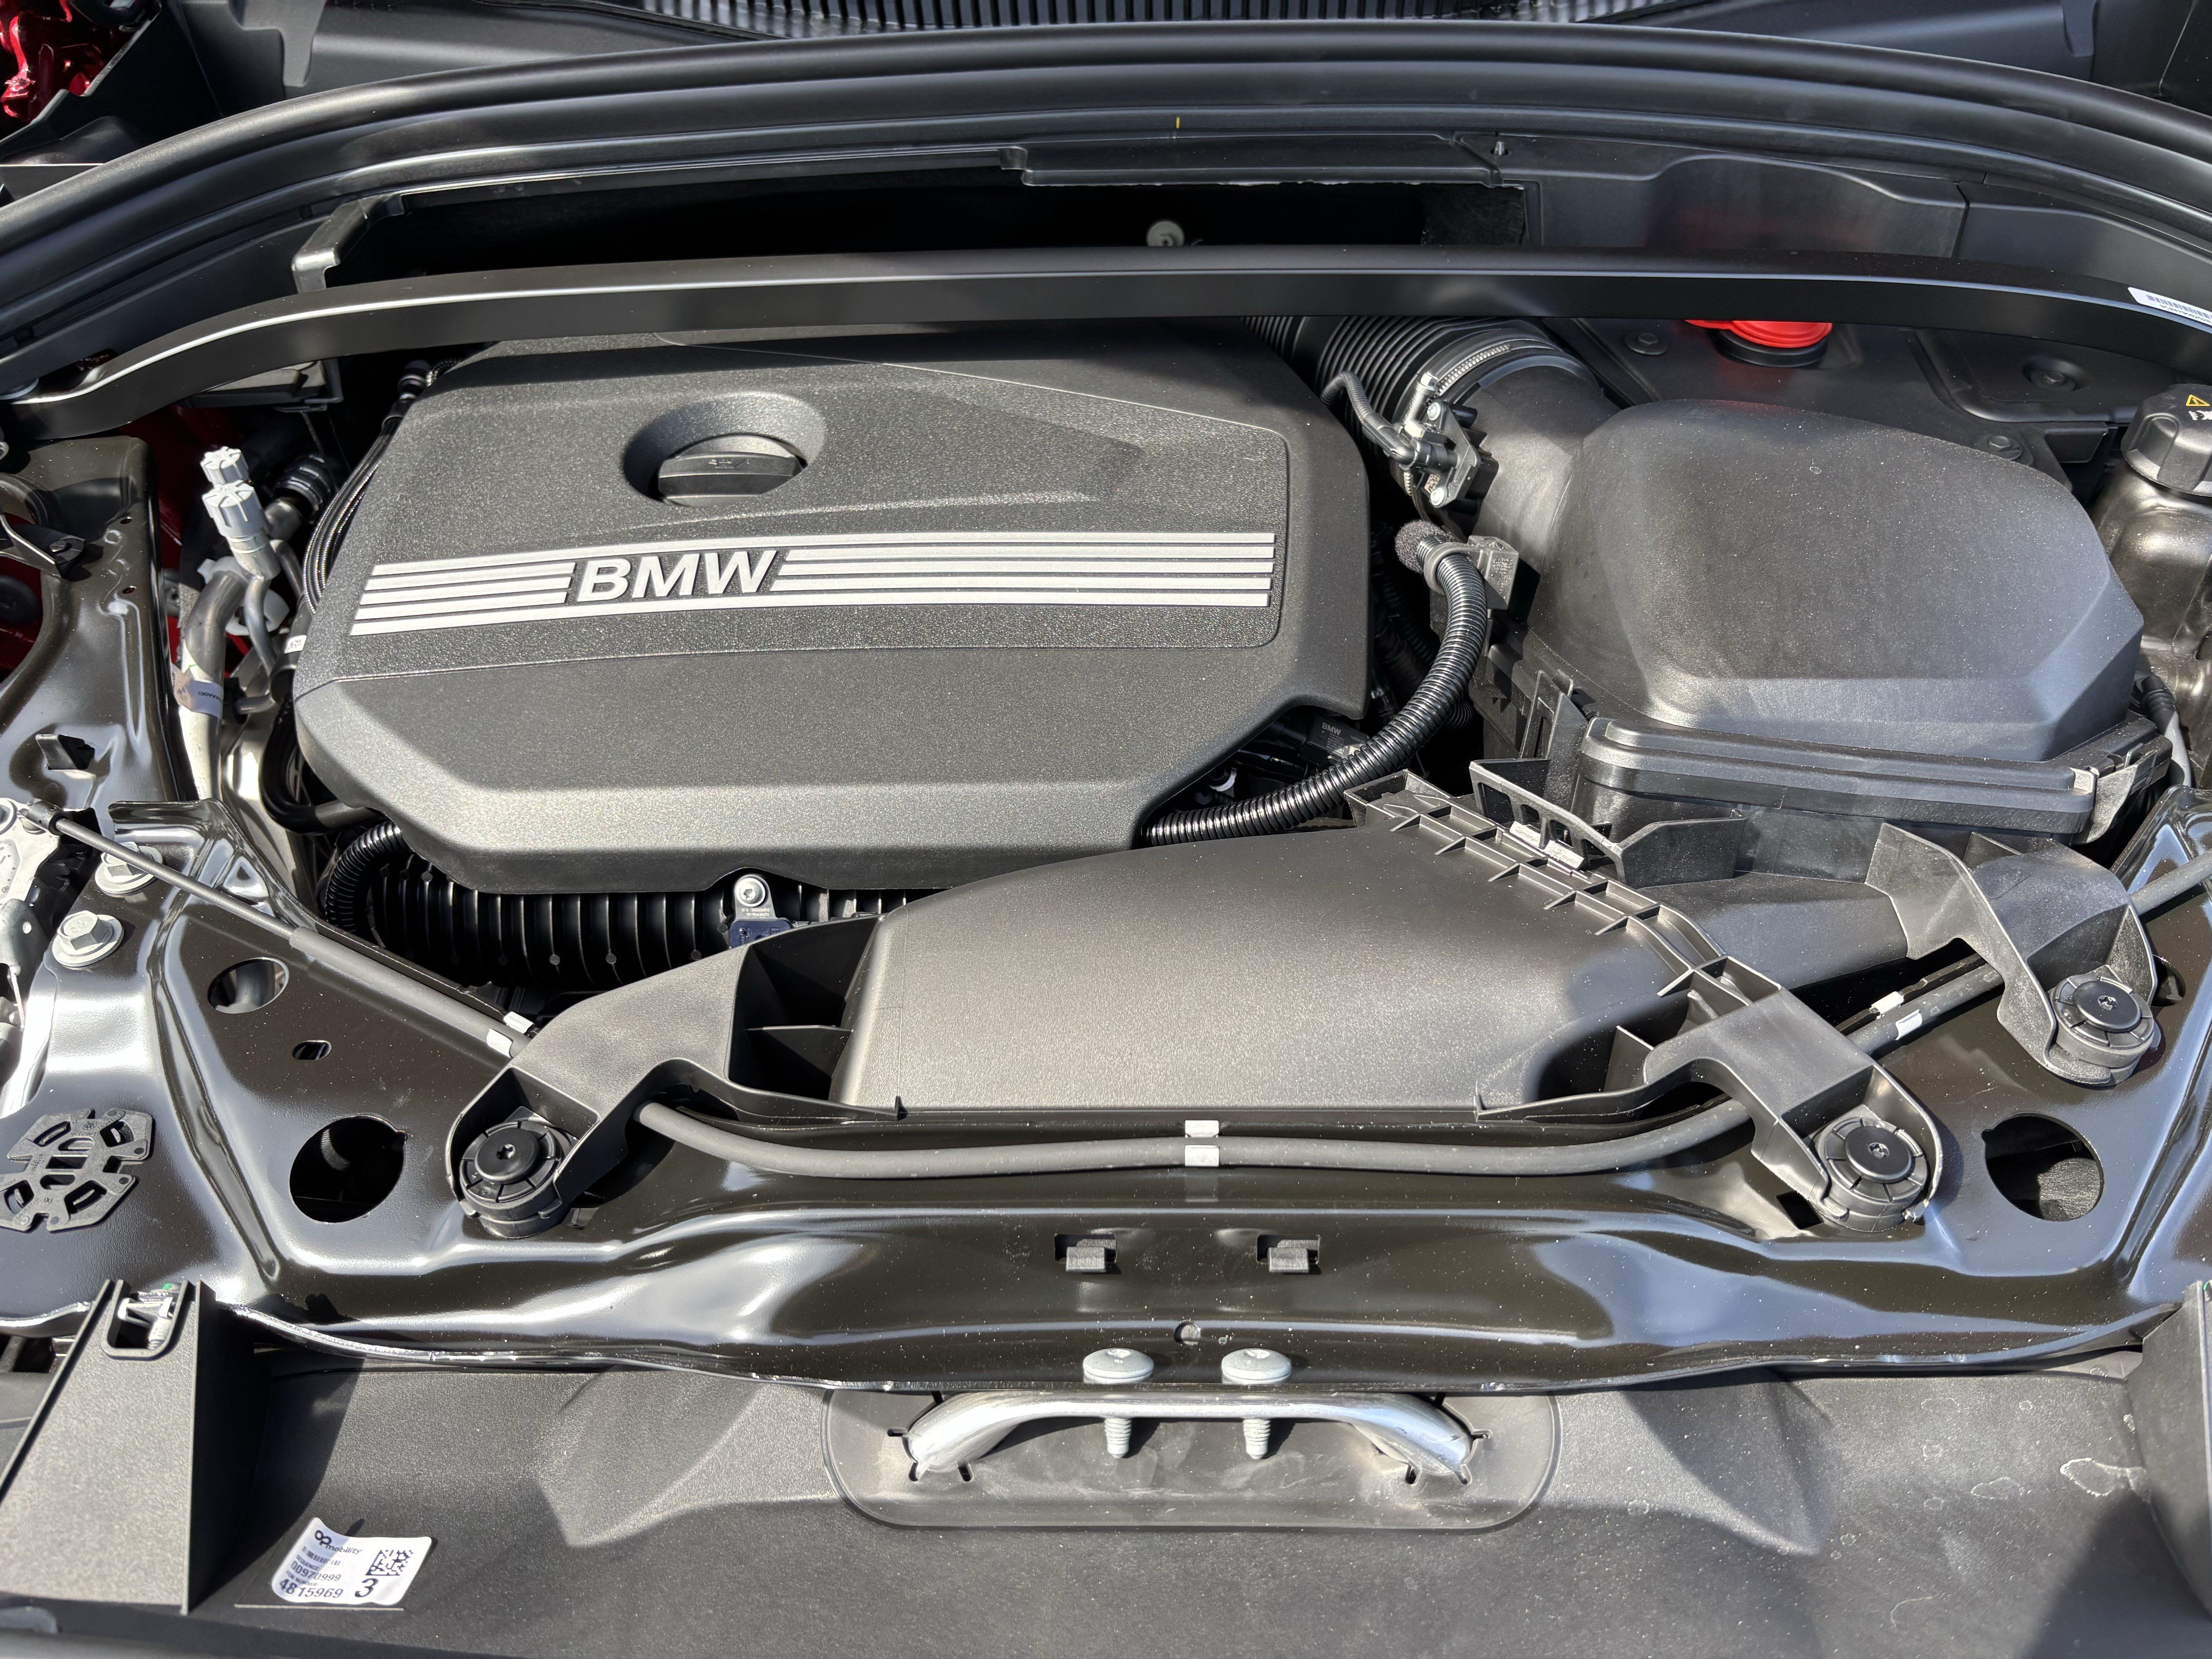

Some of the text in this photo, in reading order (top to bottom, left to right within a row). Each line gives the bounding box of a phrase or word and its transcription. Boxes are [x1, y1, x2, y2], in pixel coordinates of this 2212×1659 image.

[577, 550, 777, 602] BMW
[1322, 722, 1341, 736] BMW
[291, 1560, 342, 1581] 00970999
[279, 1578, 344, 1598] 4815969
[354, 1578, 378, 1597] 3
